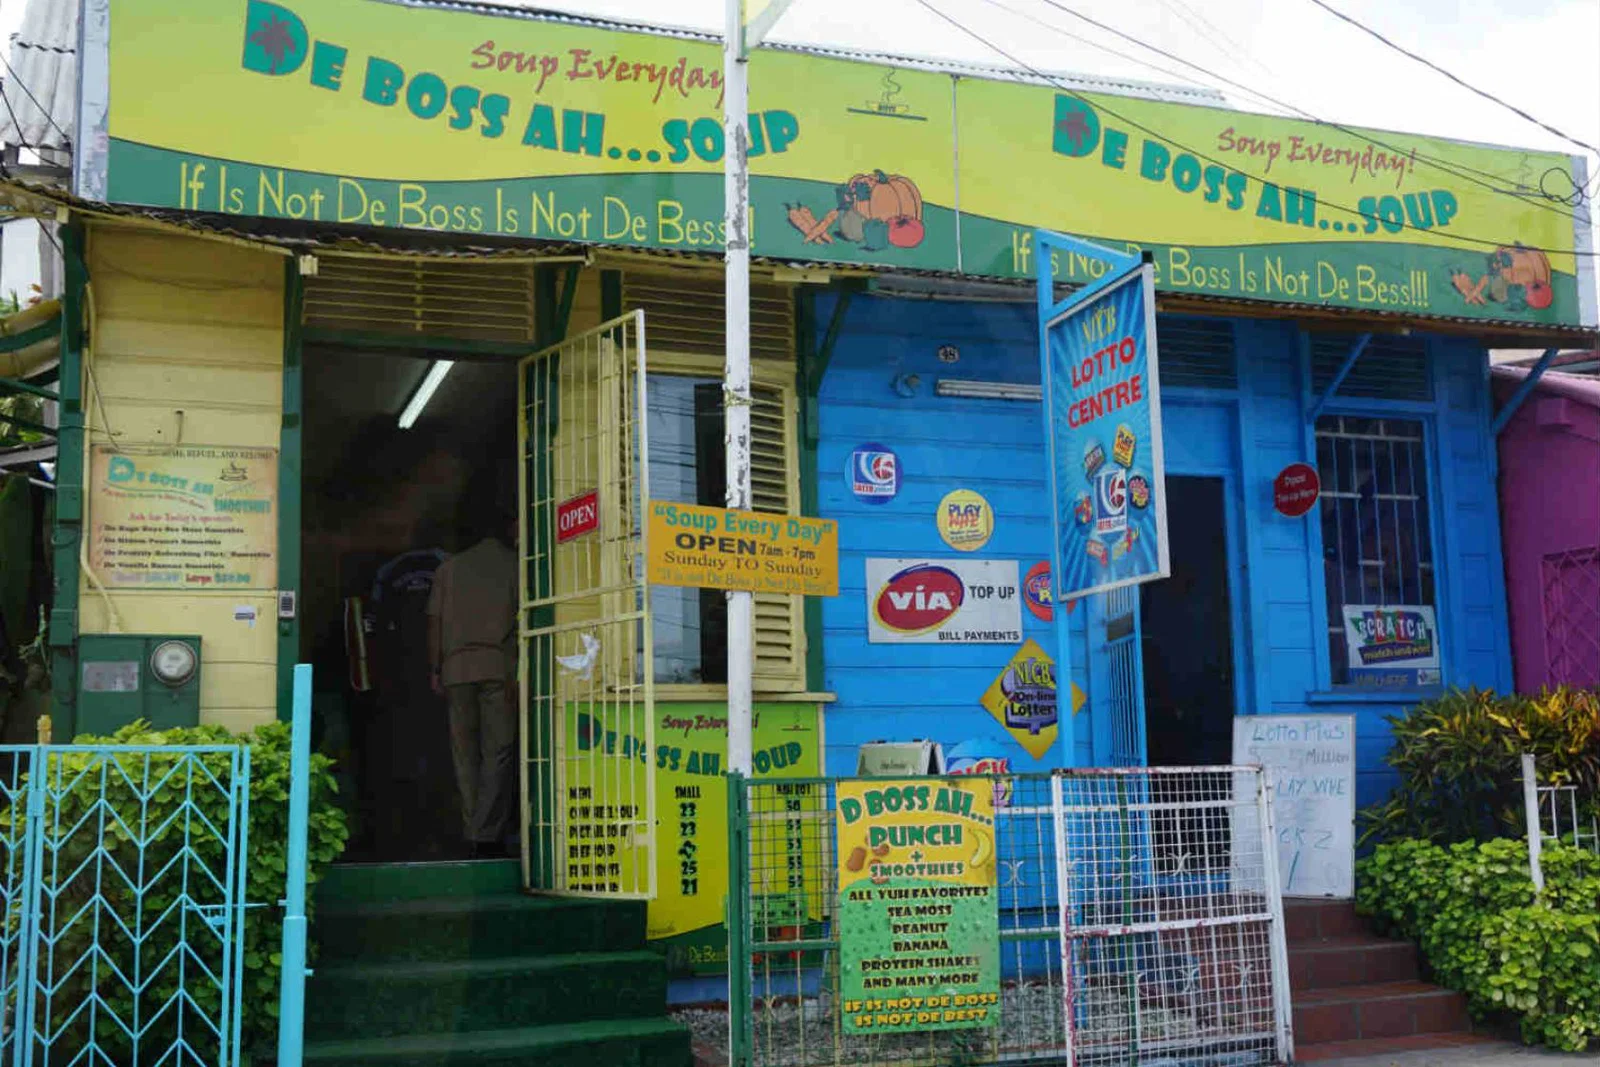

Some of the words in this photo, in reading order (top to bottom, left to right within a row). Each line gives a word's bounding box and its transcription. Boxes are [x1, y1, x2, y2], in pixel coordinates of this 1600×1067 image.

[471, 40, 560, 94] Soup
[361, 56, 510, 138] BOSS
[1218, 127, 1282, 174] Soup
[1287, 136, 1417, 190] Everyday!
[1140, 139, 1248, 211] BOSS
[180, 161, 206, 211] If
[219, 165, 244, 214] Is
[258, 170, 325, 222] Not
[337, 178, 387, 226] De
[398, 183, 483, 231] Boss
[496, 187, 519, 234] Is
[532, 191, 592, 239] Not
[603, 197, 648, 242] De
[1012, 230, 1032, 274] If
[1169, 247, 1231, 292] Boss
[1239, 253, 1257, 294] Is
[1265, 256, 1310, 298] Not
[1317, 261, 1350, 302] De
[1071, 336, 1136, 389] LOTTO
[1068, 374, 1142, 430] CENTRE
[561, 503, 596, 531] OPEN
[725, 513, 781, 541] Every
[675, 533, 757, 556] OPEN
[760, 544, 782, 559] 7am
[792, 546, 816, 561] 7pm
[664, 550, 727, 571] Sunday
[734, 558, 760, 570] TO
[765, 561, 822, 578] Sunday
[969, 586, 994, 599] TOP
[998, 586, 1015, 600] UP
[938, 631, 961, 641] BILL
[964, 631, 1019, 641] PAYMENTS
[1358, 616, 1427, 640] SCRATCH
[1011, 702, 1057, 717] Lotter
[1252, 723, 1297, 742] Lotto
[1304, 720, 1345, 742] Plus
[675, 786, 701, 799] SMALL
[840, 797, 862, 824] D
[864, 785, 931, 817] BOSS
[868, 824, 963, 847] PUNCH
[870, 862, 964, 877] SMOOTHIES
[849, 890, 873, 901] ALL
[878, 889, 910, 900] YUH
[912, 886, 989, 899] FAVORITES
[888, 905, 912, 917] SEA
[915, 904, 952, 916] MOSS
[892, 922, 949, 934] PEANUT
[893, 940, 949, 952] BANANA
[861, 958, 924, 971] PROTEIN
[863, 977, 892, 989] AND
[896, 975, 937, 987] MANY
[940, 972, 979, 984] MORE
[845, 1000, 862, 1012] IF
[866, 1000, 883, 1011] IS
[887, 998, 923, 1010] NOT
[927, 996, 950, 1007] DE
[954, 993, 998, 1005] BOSS
[855, 1015, 872, 1027] IS
[876, 1013, 913, 1025] NOT
[917, 1011, 941, 1023] DE
